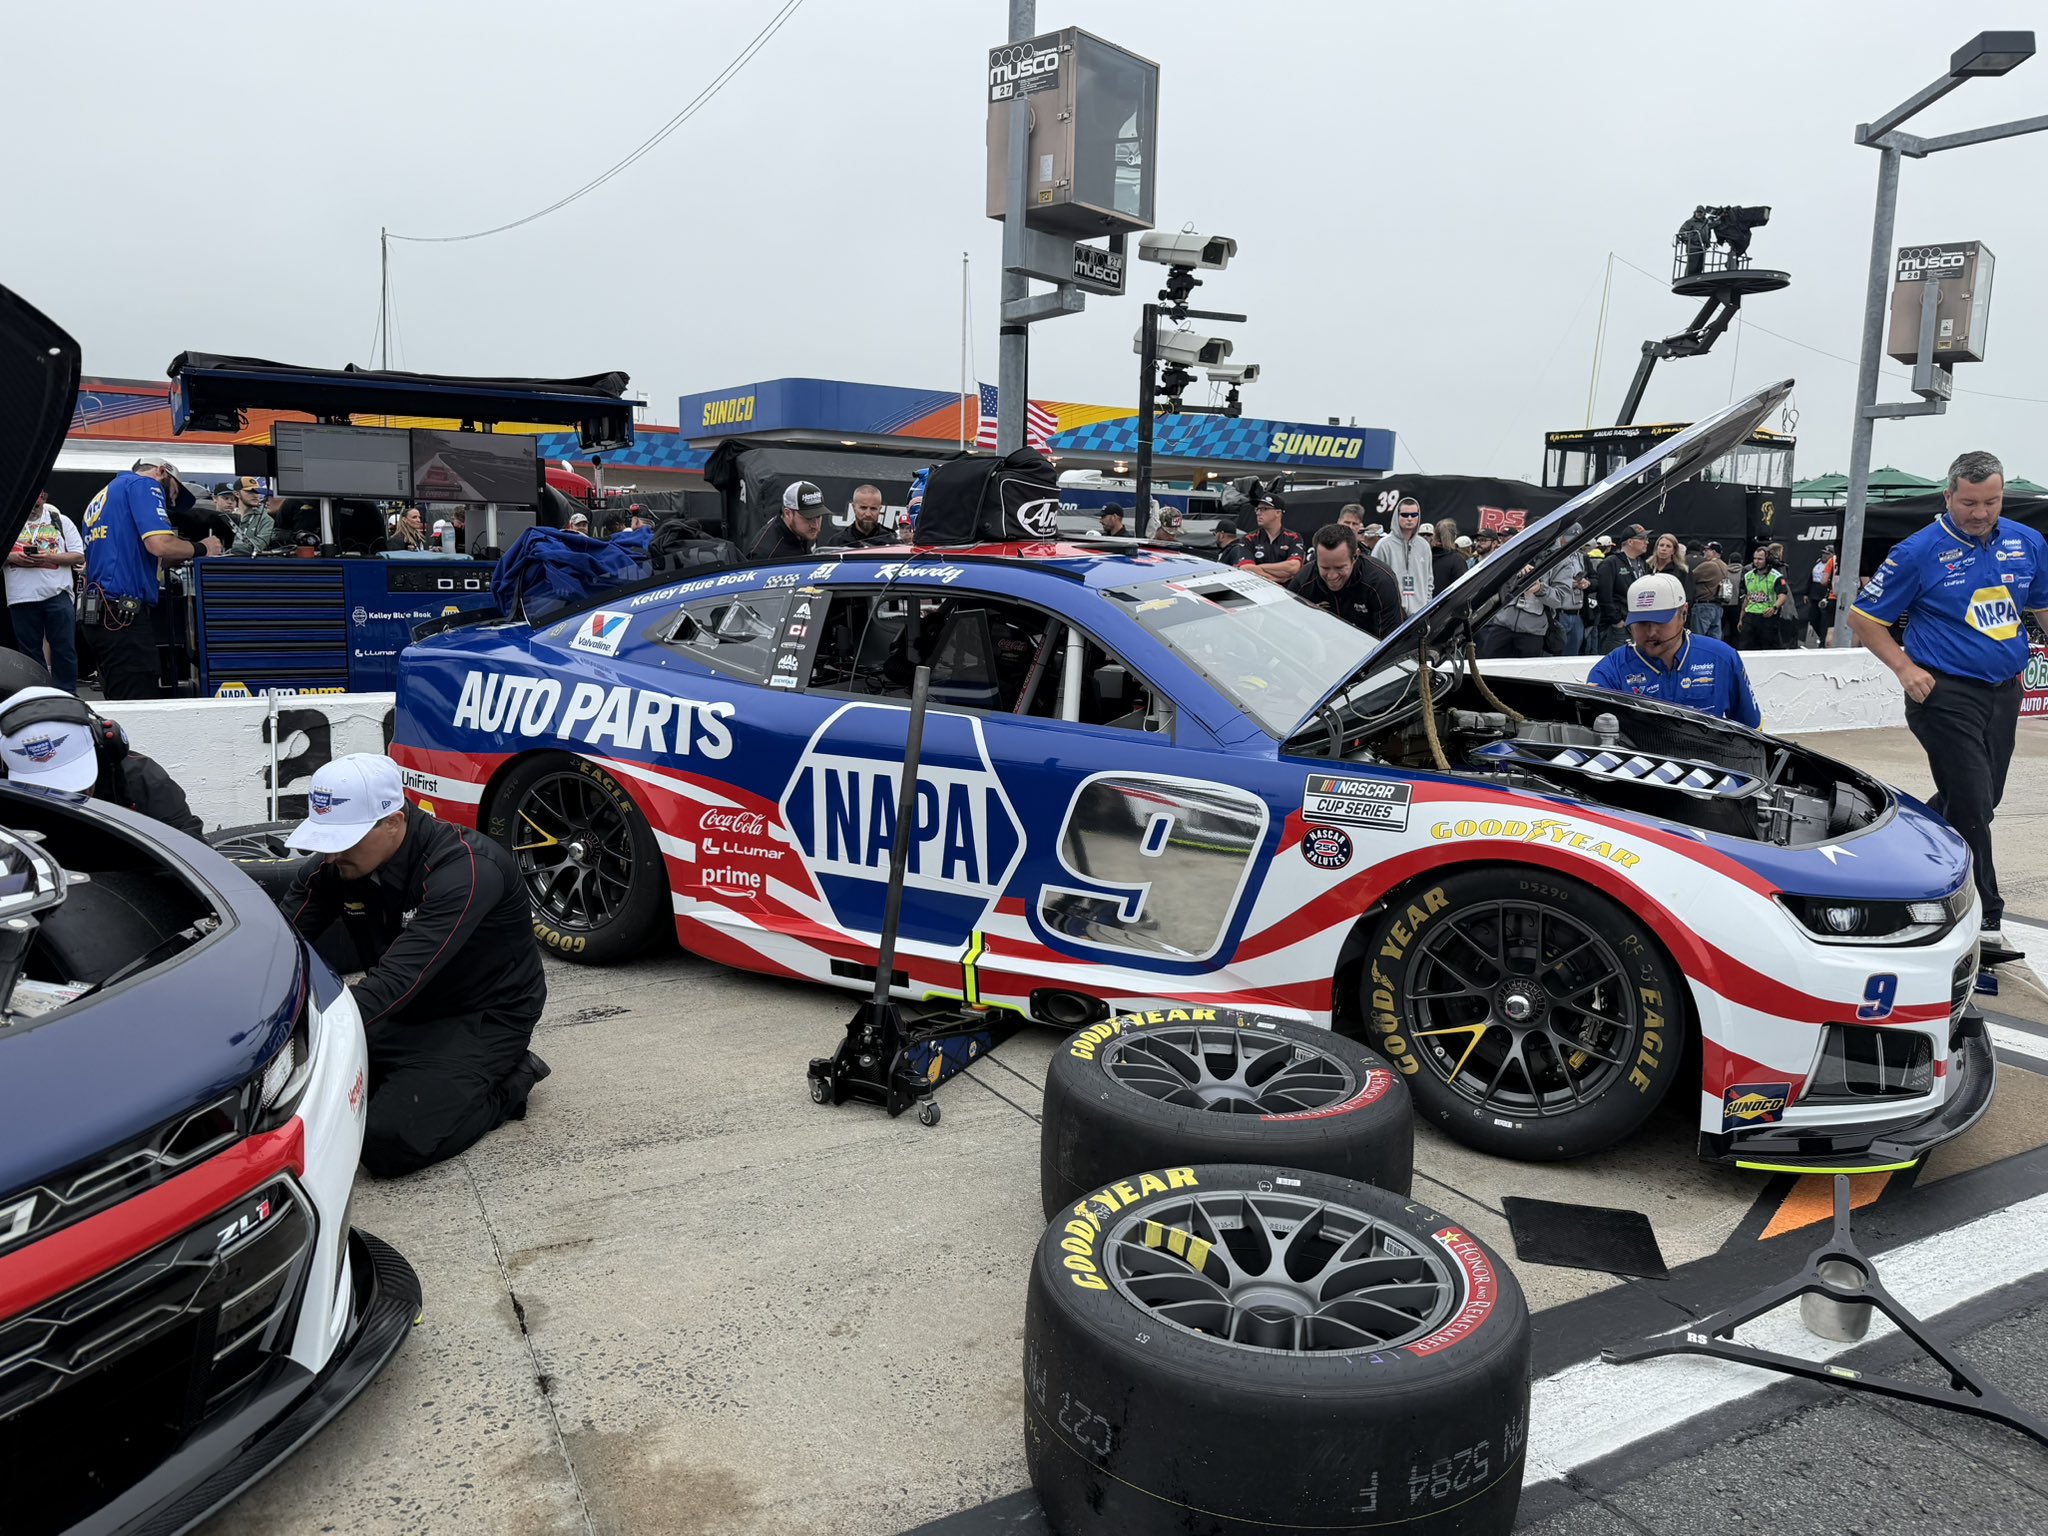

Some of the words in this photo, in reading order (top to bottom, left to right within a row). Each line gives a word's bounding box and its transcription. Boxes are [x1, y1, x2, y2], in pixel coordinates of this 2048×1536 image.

[1000, 85, 1012, 96] 27
[702, 396, 755, 427] SUNOCO
[1269, 432, 1363, 460] SUNOCO
[1376, 489, 1400, 514] 39
[874, 563, 965, 584] Rowdy
[630, 588, 679, 607] Kelley
[679, 578, 715, 594] Blue
[716, 571, 758, 586] Book
[368, 612, 392, 620] Kelley
[1973, 600, 2018, 628] NAPA
[578, 636, 611, 651] Valvoline
[452, 670, 562, 738] AUTO
[556, 682, 736, 760] PARTS
[2020, 697, 2042, 712] AUTO
[401, 770, 438, 793] UniFirst
[579, 760, 633, 814] EAGLE
[1338, 775, 1396, 799] NASCAR
[1317, 798, 1344, 815] CUP
[1345, 801, 1393, 819] SERIES
[824, 768, 981, 884] NAPA
[1309, 829, 1346, 845] NASCAR
[722, 844, 785, 860] LLumar
[1306, 850, 1346, 866] SALUTES
[1315, 843, 1339, 852] 250
[701, 866, 761, 889] prime
[1036, 770, 1271, 962] 9
[1856, 971, 1898, 1020] 9
[1628, 986, 1665, 1095] EAGLE
[1724, 1097, 1785, 1117] SUNOCO
[216, 1199, 270, 1252] ZL1
[1453, 1241, 1491, 1285] HONOR
[1476, 1285, 1486, 1300] AND
[1413, 1300, 1491, 1352] REMEMBER
[1686, 1331, 1708, 1345] RS
